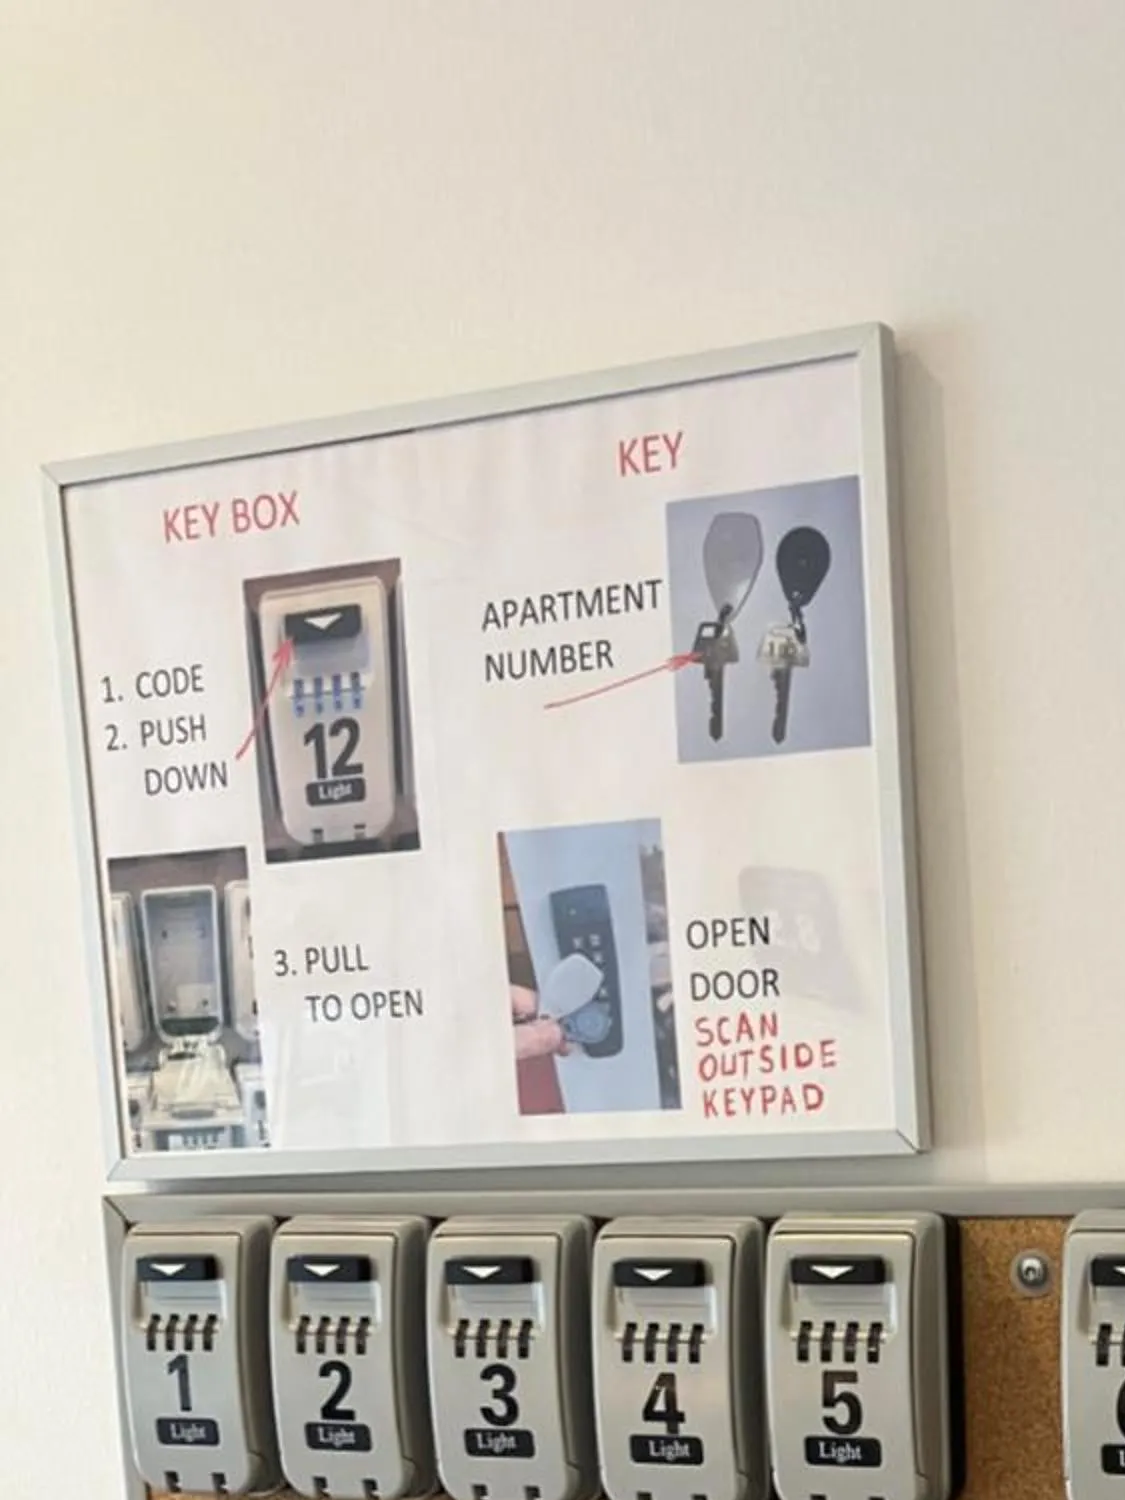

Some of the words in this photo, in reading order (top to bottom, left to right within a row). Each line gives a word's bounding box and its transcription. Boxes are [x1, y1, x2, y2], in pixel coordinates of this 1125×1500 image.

[618, 432, 683, 476] KEY
[162, 502, 219, 543] KEY
[232, 491, 300, 533] BOX
[482, 579, 662, 631] APARTMENT
[485, 640, 613, 682] NUMBER
[101, 677, 123, 703] 1.
[136, 665, 205, 699] CODE
[106, 725, 127, 751] 2.
[141, 715, 206, 747] PUSH
[304, 717, 363, 779] 12
[145, 761, 228, 796] DOWN
[318, 783, 353, 800] Light
[687, 916, 770, 949] OPEN
[275, 950, 297, 976] 3.
[305, 944, 369, 974] PULL
[691, 968, 780, 1001] DOOR
[305, 995, 342, 1022] TO
[351, 989, 423, 1020] OPEN
[696, 1012, 778, 1047] SCAN
[699, 1040, 837, 1082] OUTSIDE
[703, 1083, 824, 1119] KEYPAD
[167, 1354, 192, 1412] 1
[319, 1360, 355, 1421] 2
[480, 1363, 519, 1426] 3
[642, 1372, 685, 1435] 4
[822, 1370, 862, 1435] 5
[170, 1424, 206, 1441] Light
[317, 1429, 355, 1446] Light
[476, 1434, 516, 1452] Light
[649, 1441, 690, 1461] Light
[819, 1443, 862, 1463] Light
